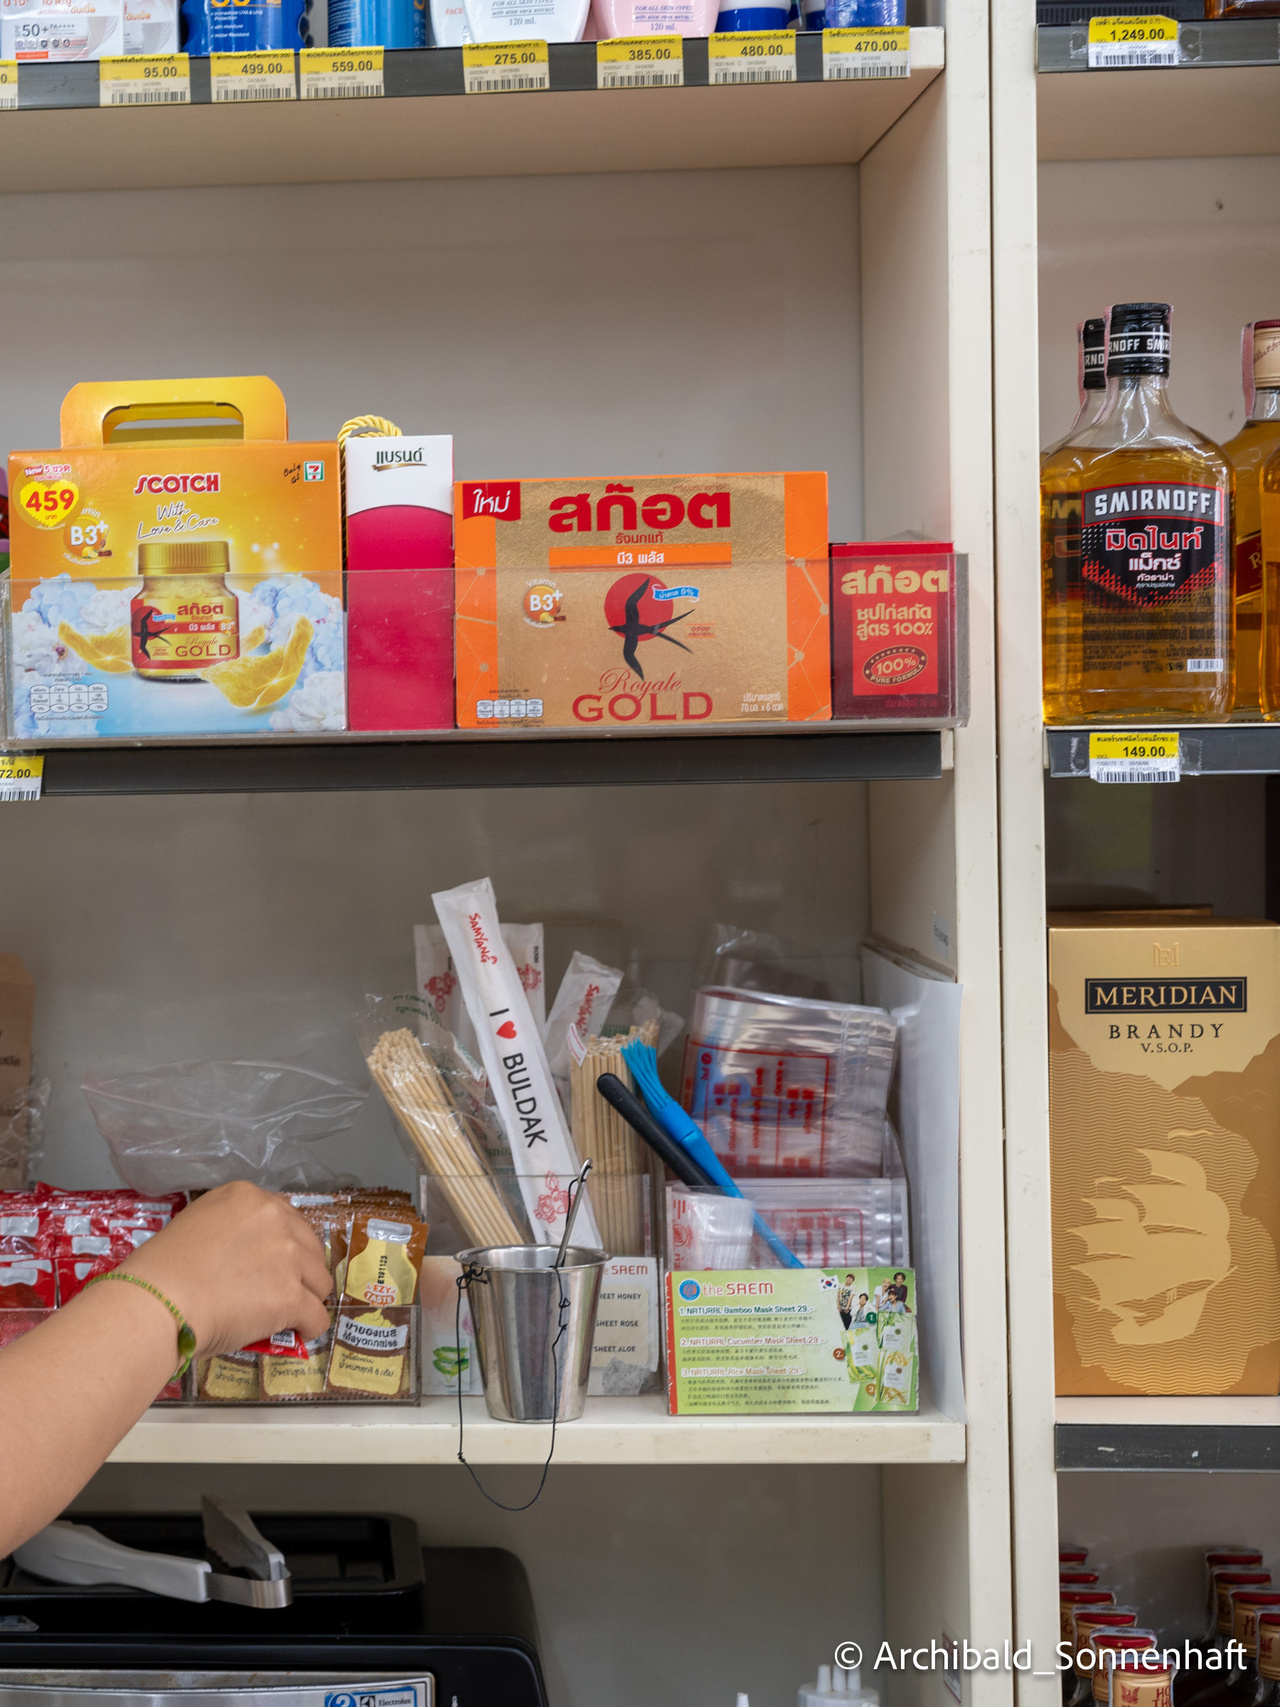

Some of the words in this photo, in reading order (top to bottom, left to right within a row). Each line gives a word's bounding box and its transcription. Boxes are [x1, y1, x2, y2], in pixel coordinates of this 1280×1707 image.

[1110, 28, 1165, 43] 1,249.00
[739, 43, 784, 57] 480.00
[854, 39, 898, 52] 470.00
[493, 52, 536, 66] 275.00
[628, 48, 671, 62] 385.00
[143, 66, 178, 78] 95.00
[241, 63, 283, 75] 499.00
[331, 60, 373, 72] 559.00
[134, 472, 220, 496] SCOTCH
[26, 489, 75, 512] 459
[473, 488, 509, 514] ใหม่
[548, 482, 731, 533] สก๊อต
[1095, 488, 1212, 516] SMIRNOFF
[137, 521, 173, 540] Love
[1105, 525, 1204, 551] มิดไนท์
[841, 564, 948, 595] สก๊อต
[529, 589, 563, 612] B3+
[856, 602, 932, 621] ซุปไก่สกัด
[856, 622, 890, 641] สูตร
[893, 622, 933, 636] 100%
[175, 644, 231, 657] GOLD
[876, 656, 918, 675] 100%
[599, 667, 682, 702] Royale
[870, 674, 891, 684] PURE
[572, 691, 713, 723] GOLD
[1123, 745, 1166, 758] 149.00
[468, 912, 497, 965] SAMYANG
[1095, 985, 1238, 1007] MERIDIAN
[1109, 1023, 1224, 1039] BRANDY
[1141, 1042, 1193, 1053] V.S.O.P.
[502, 1052, 548, 1148] BULDAK
[611, 1264, 648, 1275] SAEM
[373, 1284, 391, 1294] EZY
[703, 1283, 723, 1296] the
[726, 1282, 773, 1296] SAEM
[365, 1292, 394, 1304] TASTE
[724, 1306, 753, 1314] Bamboo
[774, 1305, 796, 1313] Sheet
[345, 1322, 397, 1338] มายองเนส
[341, 1330, 398, 1347] Mayonnaise
[727, 1337, 763, 1345] Cucumber
[764, 1336, 784, 1344] Mask
[785, 1336, 806, 1344] Sheet
[594, 1345, 615, 1353] SHEET
[618, 1345, 636, 1353] ALOE
[745, 1367, 764, 1375] Mask
[378, 1698, 412, 1707] Electrolux
